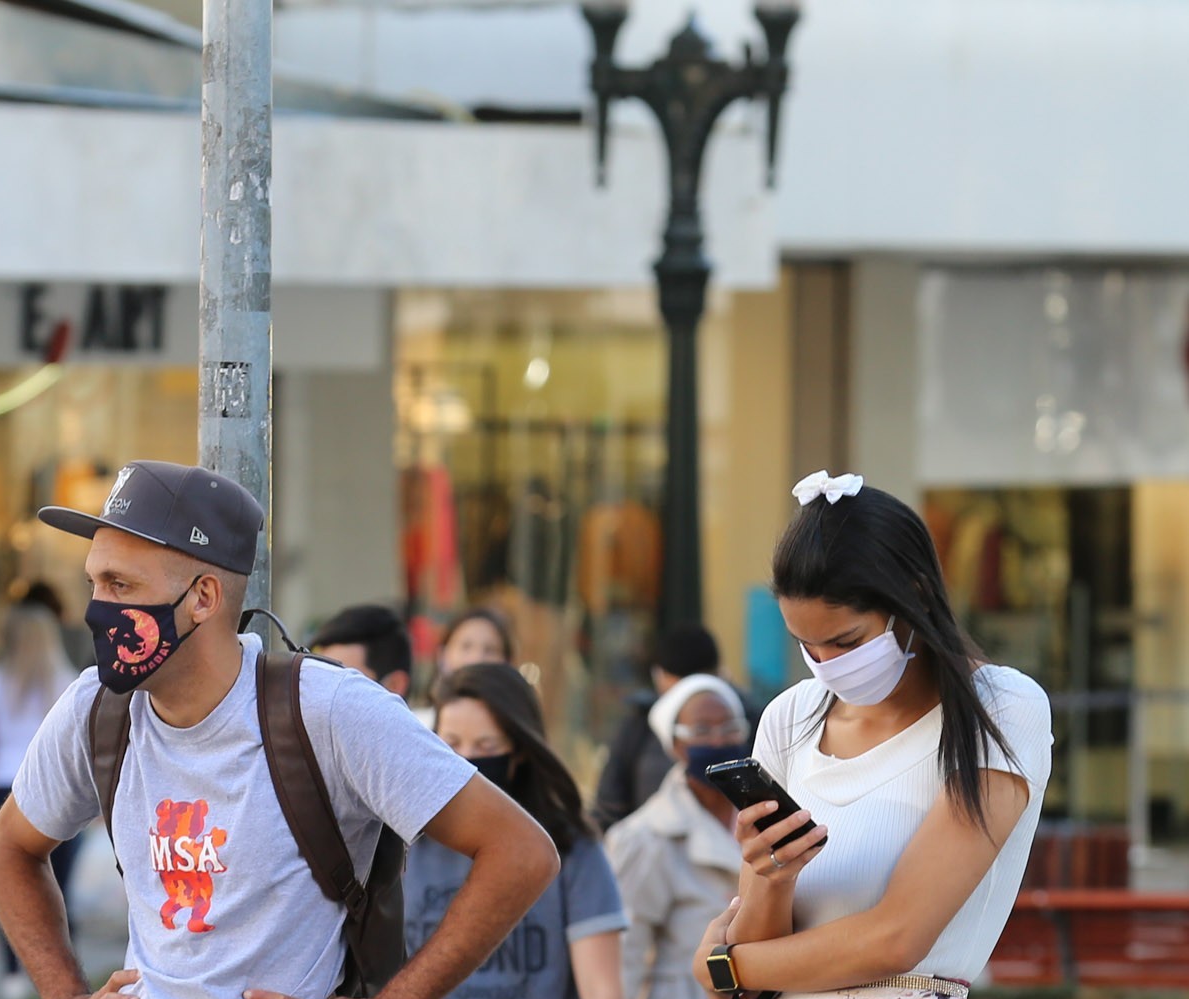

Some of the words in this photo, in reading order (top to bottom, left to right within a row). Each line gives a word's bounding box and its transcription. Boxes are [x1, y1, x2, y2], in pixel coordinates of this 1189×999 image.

[112, 660, 125, 674] EL
[131, 641, 171, 676] SHADAY
[149, 834, 226, 873] MSA
